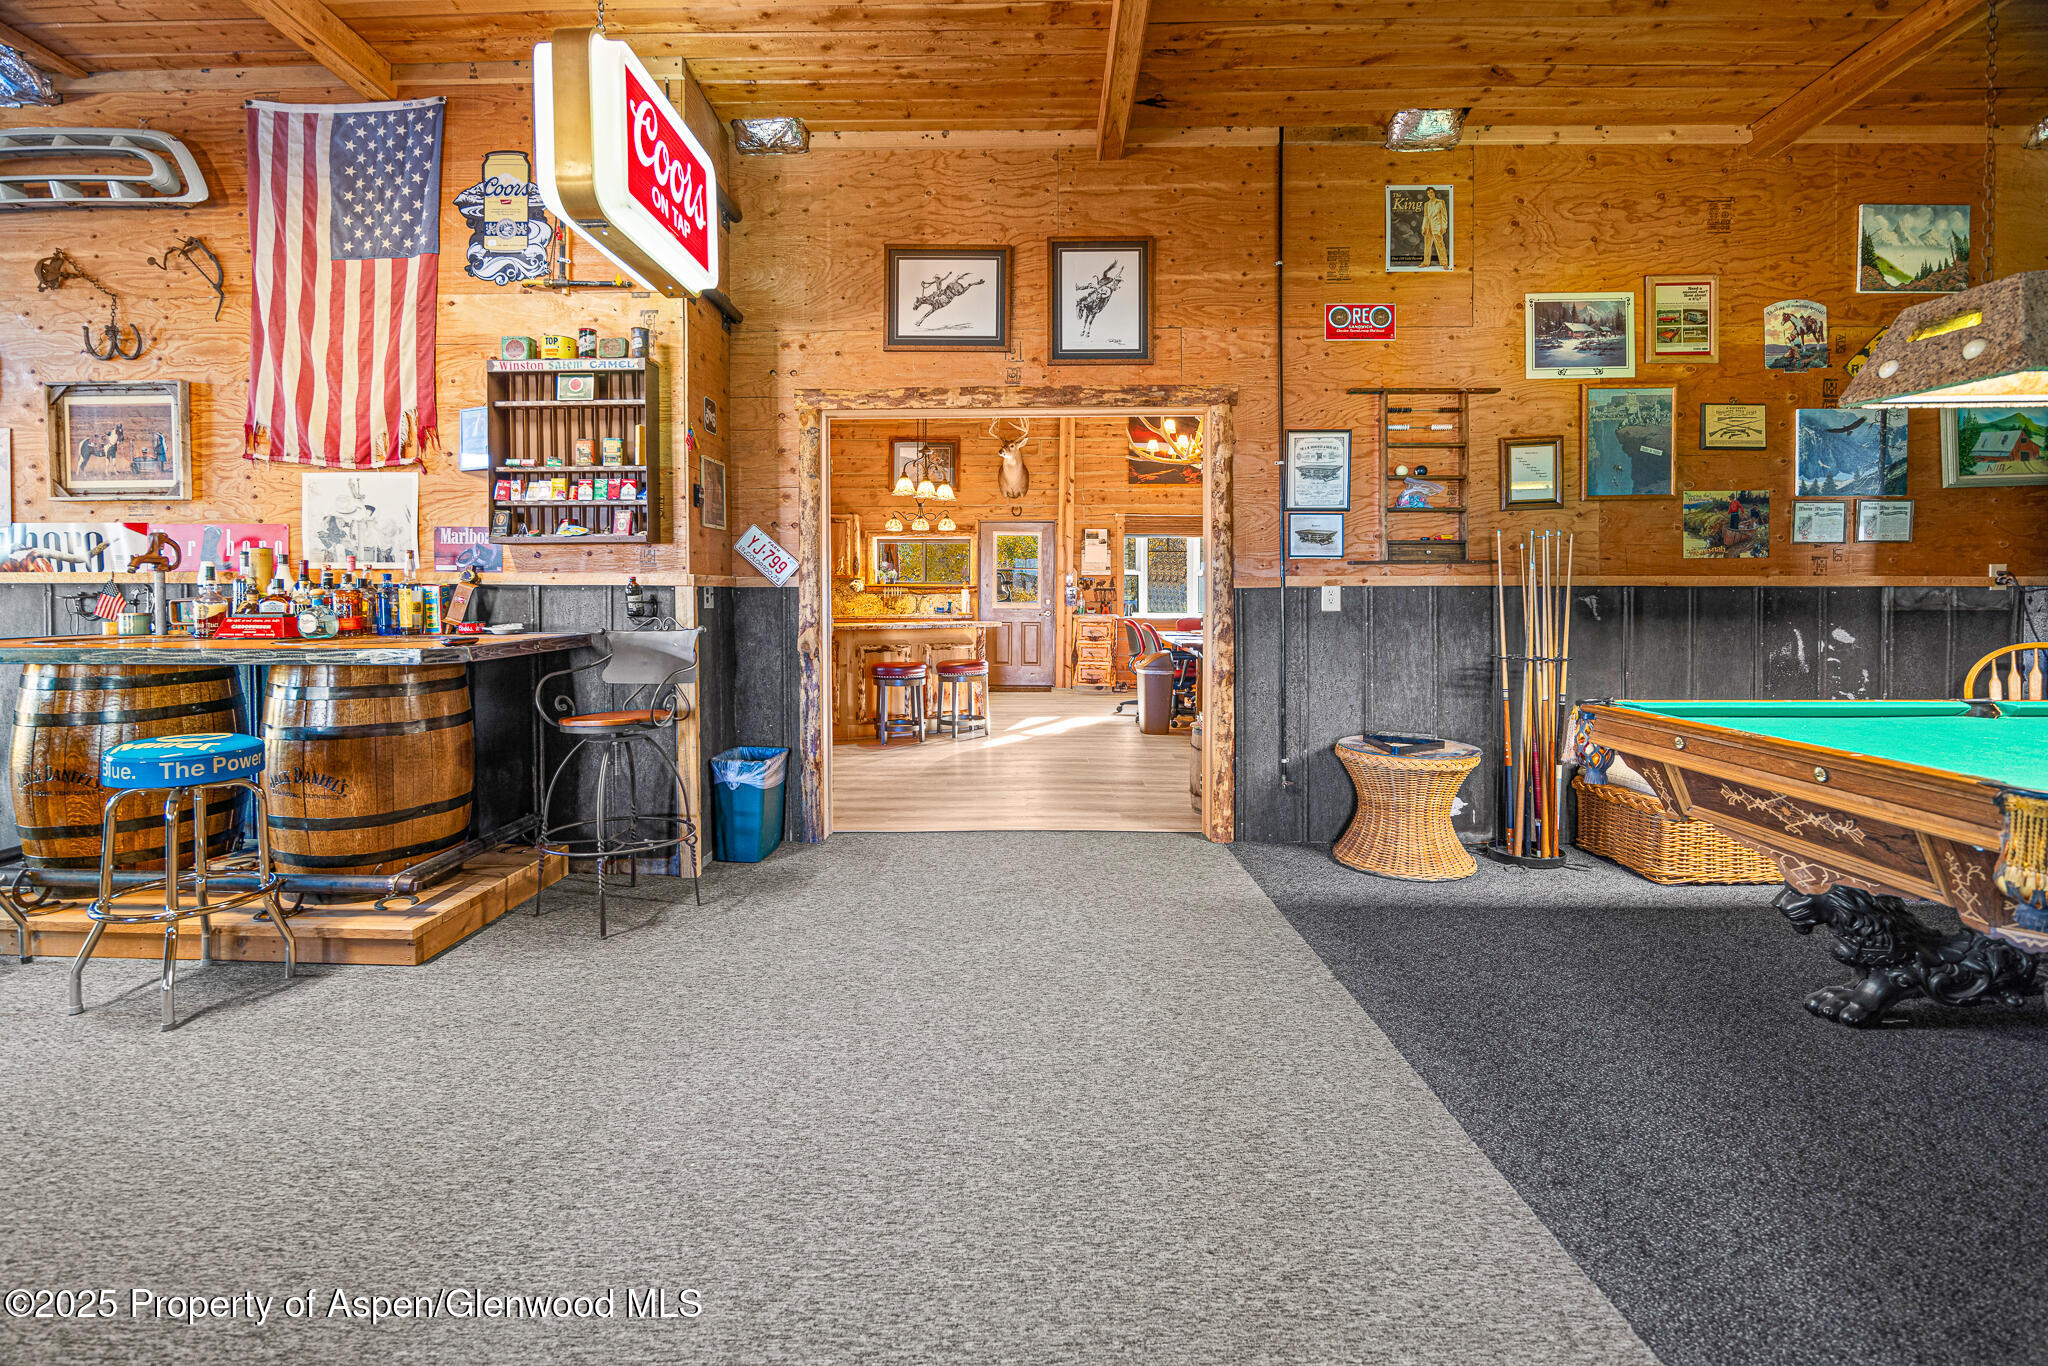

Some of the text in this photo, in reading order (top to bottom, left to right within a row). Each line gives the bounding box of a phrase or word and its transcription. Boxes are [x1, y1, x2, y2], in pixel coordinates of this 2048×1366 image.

[630, 99, 707, 230] Coors
[483, 176, 529, 197] Coors
[651, 185, 691, 239] ON TAP
[1391, 197, 1424, 213] King
[1328, 305, 1393, 329] OREO
[545, 336, 559, 346] TOP
[499, 360, 636, 370] Winston Salem CAMEL
[440, 528, 490, 545] Marlbor
[102, 751, 263, 780] Blue. The Power
[269, 766, 349, 795] JACK DANIEL'S
